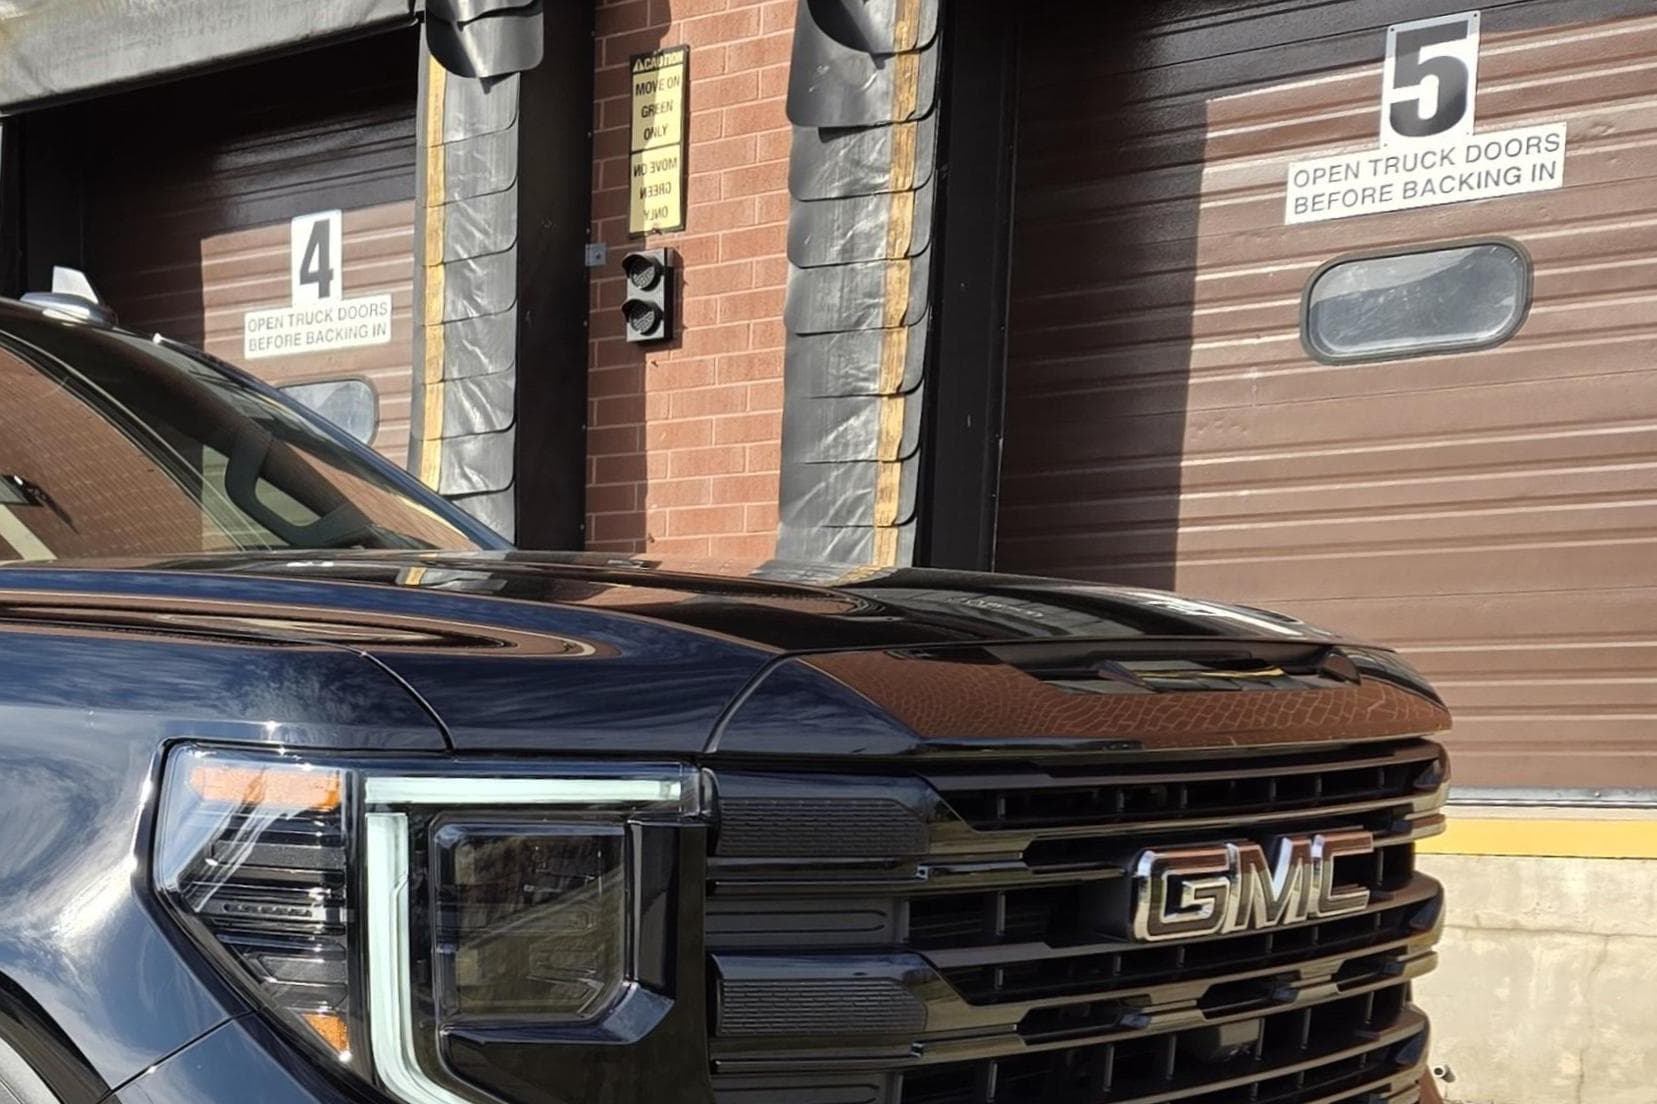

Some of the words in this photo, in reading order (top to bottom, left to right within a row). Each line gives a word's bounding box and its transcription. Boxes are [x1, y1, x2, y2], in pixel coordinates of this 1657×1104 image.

[635, 78, 665, 96] MOVE
[667, 74, 680, 89] ON
[1389, 20, 1469, 137] 5
[641, 100, 673, 118] GREEN
[644, 124, 668, 141] ONLY
[1293, 161, 1360, 188] OPEN
[1369, 148, 1456, 176] TRUCK
[1465, 134, 1560, 163] DOORS
[1294, 184, 1393, 215] BEFORE
[1403, 167, 1522, 199] BACKING
[1531, 161, 1557, 181] IN
[299, 219, 334, 299] 4
[248, 315, 284, 333] OPEN
[288, 307, 333, 327] TRUCK
[337, 302, 388, 322] DOORS
[249, 332, 301, 352] BEFORE
[306, 324, 369, 345] BACKING
[372, 322, 387, 337] IN
[1134, 831, 1375, 941] GMC
